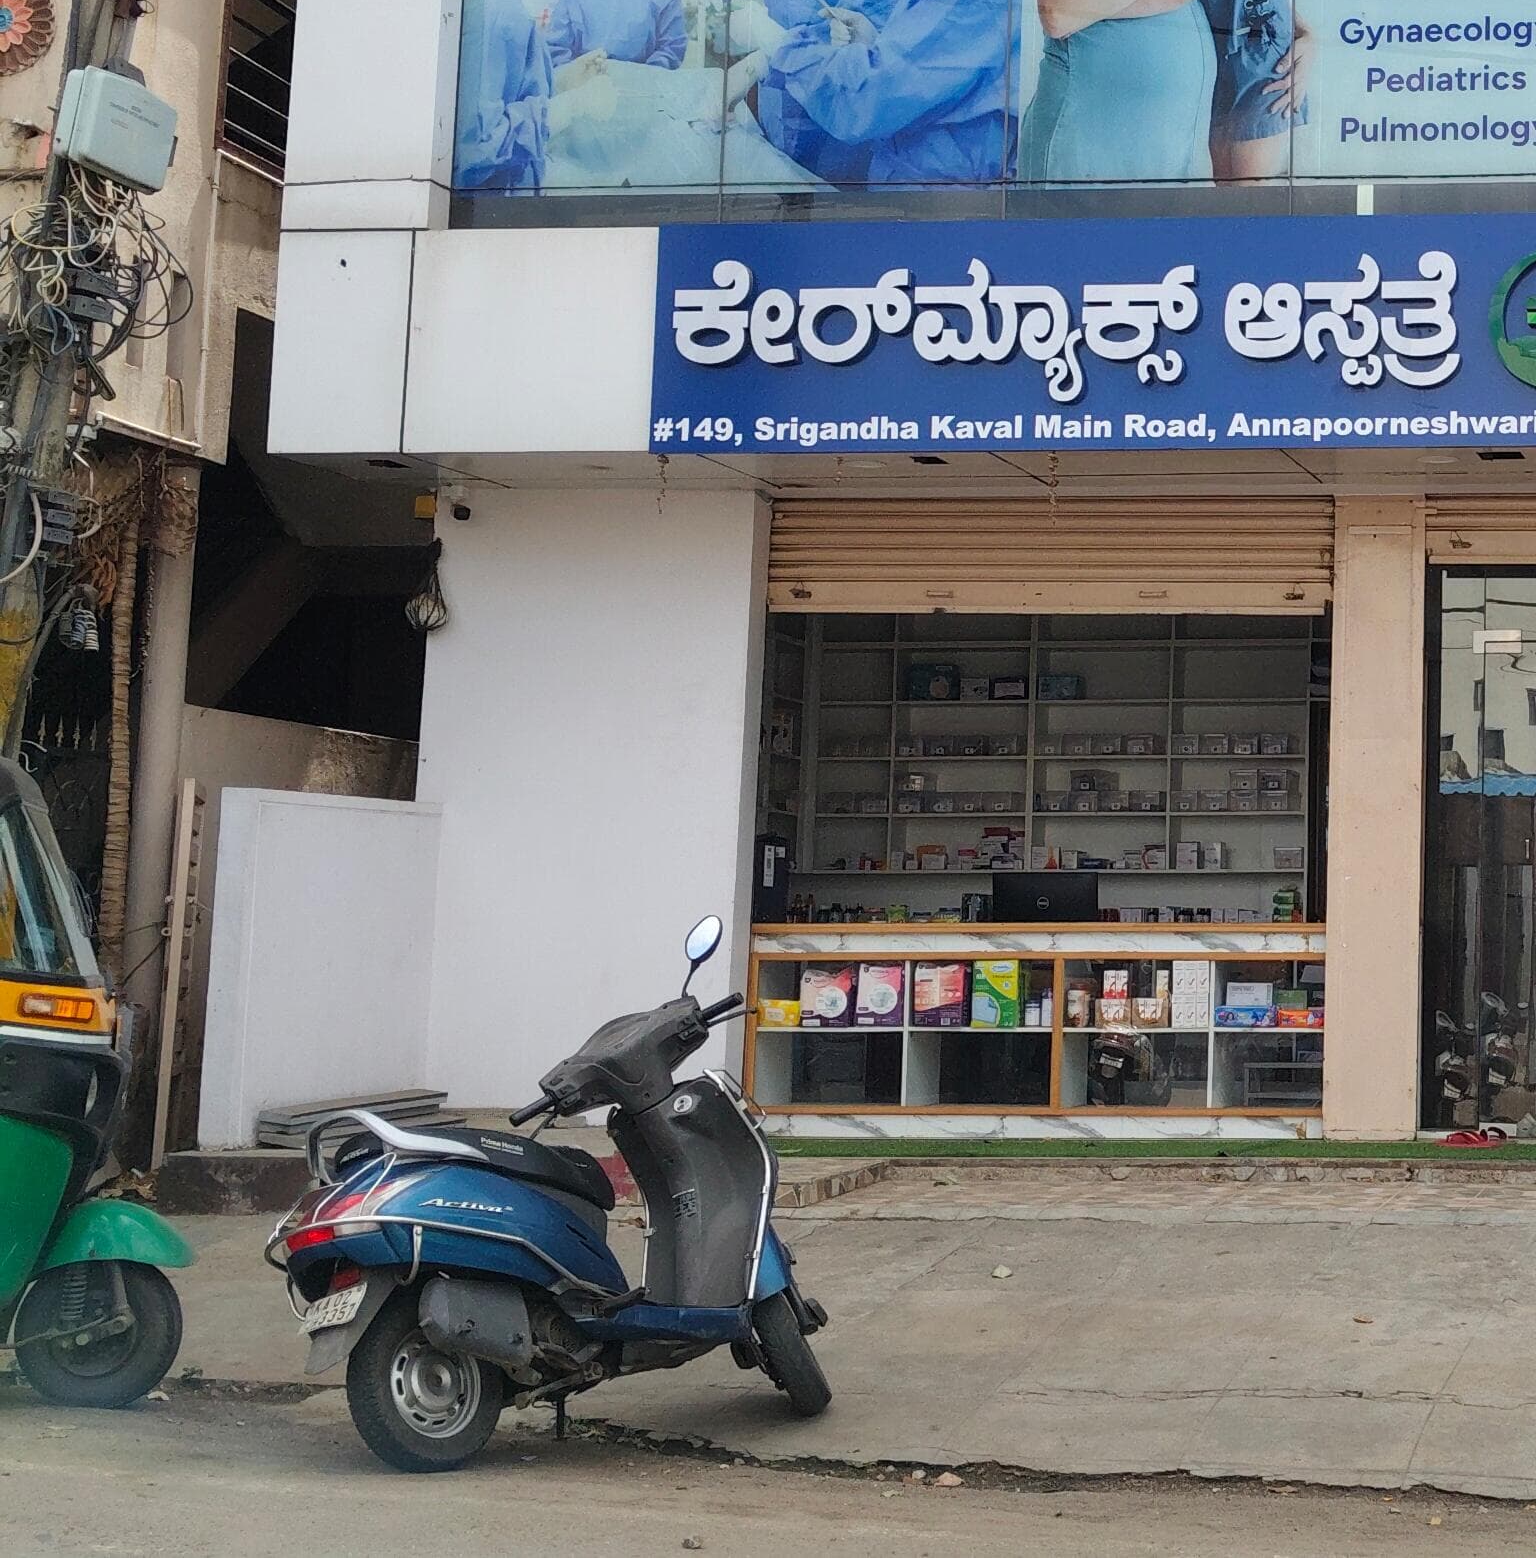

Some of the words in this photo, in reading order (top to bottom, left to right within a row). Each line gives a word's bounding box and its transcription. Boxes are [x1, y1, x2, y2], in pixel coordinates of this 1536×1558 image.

[1366, 65, 1527, 92] Pediatrics
[654, 416, 743, 444] #149,
[754, 414, 918, 445] Srigandha
[930, 414, 1022, 440] Kaval
[1033, 413, 1113, 440] Main
[1124, 412, 1217, 441] Road,
[418, 1198, 503, 1213] Activa
